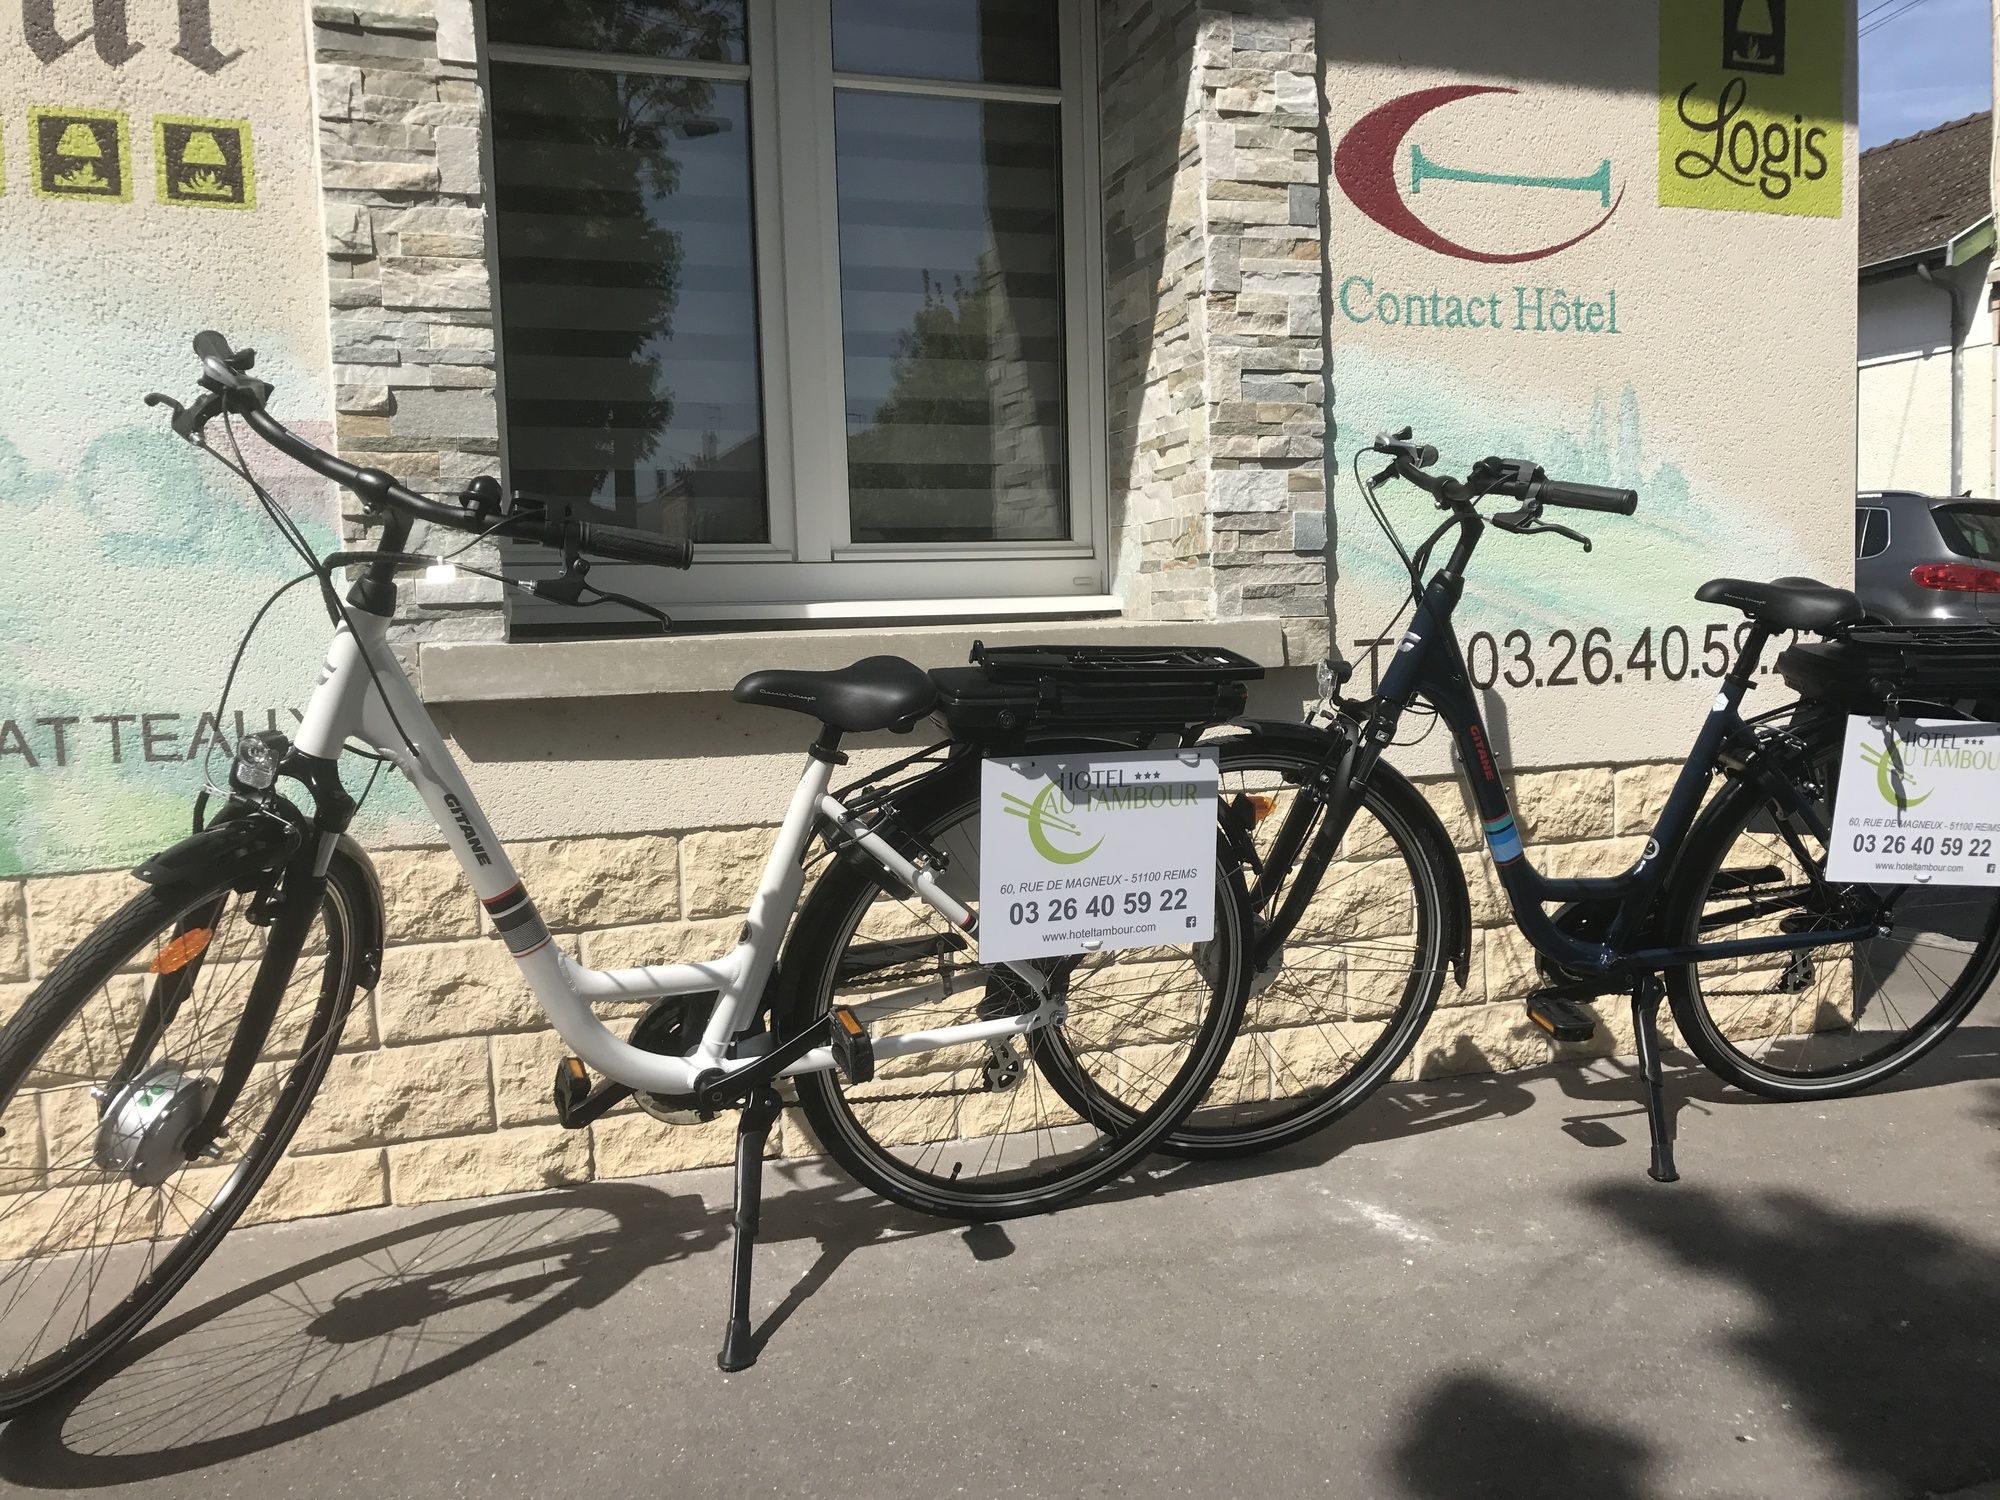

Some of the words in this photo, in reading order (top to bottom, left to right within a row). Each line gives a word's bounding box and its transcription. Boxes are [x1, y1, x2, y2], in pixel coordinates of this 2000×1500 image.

[1675, 77, 1827, 200] Logis
[1339, 275, 1502, 328] Contact
[1512, 286, 1622, 334] Hôtel
[1470, 724, 1495, 781] GITANE
[1905, 731, 1961, 750] HOTEL
[1060, 769, 1131, 791] HOTEL
[1042, 792, 1074, 815] AU
[1086, 783, 1199, 812] TAMBOUR
[443, 793, 492, 867] GITANE
[1849, 818, 1861, 828] 60,
[1863, 819, 1884, 828] RUE
[1885, 819, 1897, 828] DE
[1899, 820, 1944, 830] MAGNEUX
[1949, 822, 1973, 831] 51100
[1853, 834, 1876, 853] 03
[1882, 835, 1905, 854] 26
[1911, 836, 1934, 855] 40
[1940, 838, 1963, 856] 59
[1968, 838, 1992, 857] 22
[1875, 862, 1964, 872] www.hoteltambour.com
[1000, 883, 1016, 895] 60,
[1019, 881, 1044, 894] RUE
[1047, 879, 1063, 891] DE
[1065, 873, 1122, 889] MAGNEUX
[1131, 871, 1161, 885] 51100
[1163, 868, 1198, 881] REIMS
[1009, 901, 1040, 925] 03
[1047, 897, 1078, 922] 26
[1085, 894, 1115, 918] 40
[1123, 891, 1152, 915] 59
[1159, 887, 1188, 912] 22
[1042, 922, 1156, 942] www.hoteltambour.com
